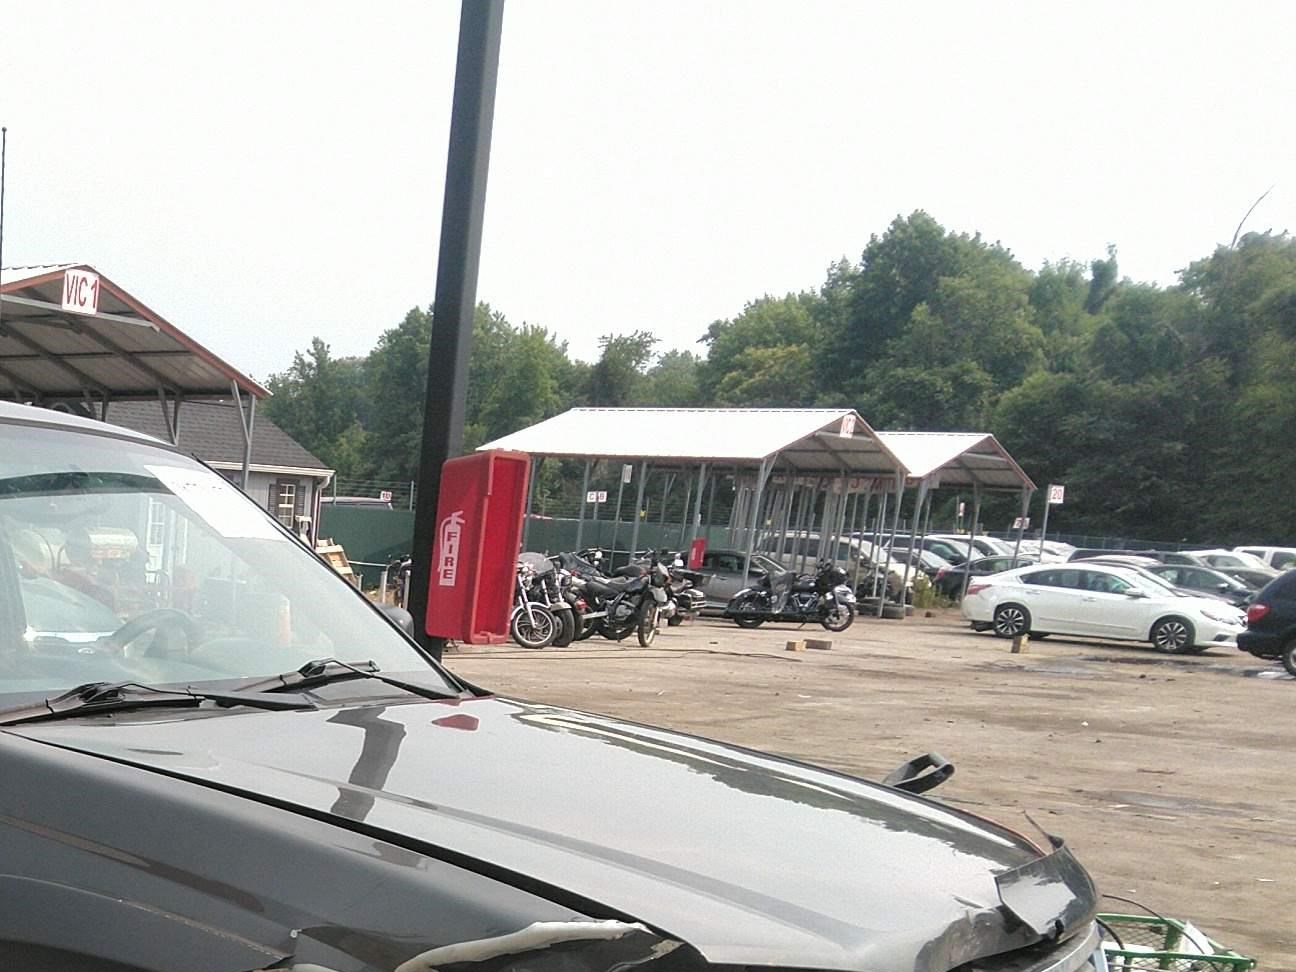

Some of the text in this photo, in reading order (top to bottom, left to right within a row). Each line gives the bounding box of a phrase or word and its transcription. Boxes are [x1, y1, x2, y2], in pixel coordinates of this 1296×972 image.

[66, 273, 98, 309] VIC 1
[443, 531, 458, 580] FIRE
